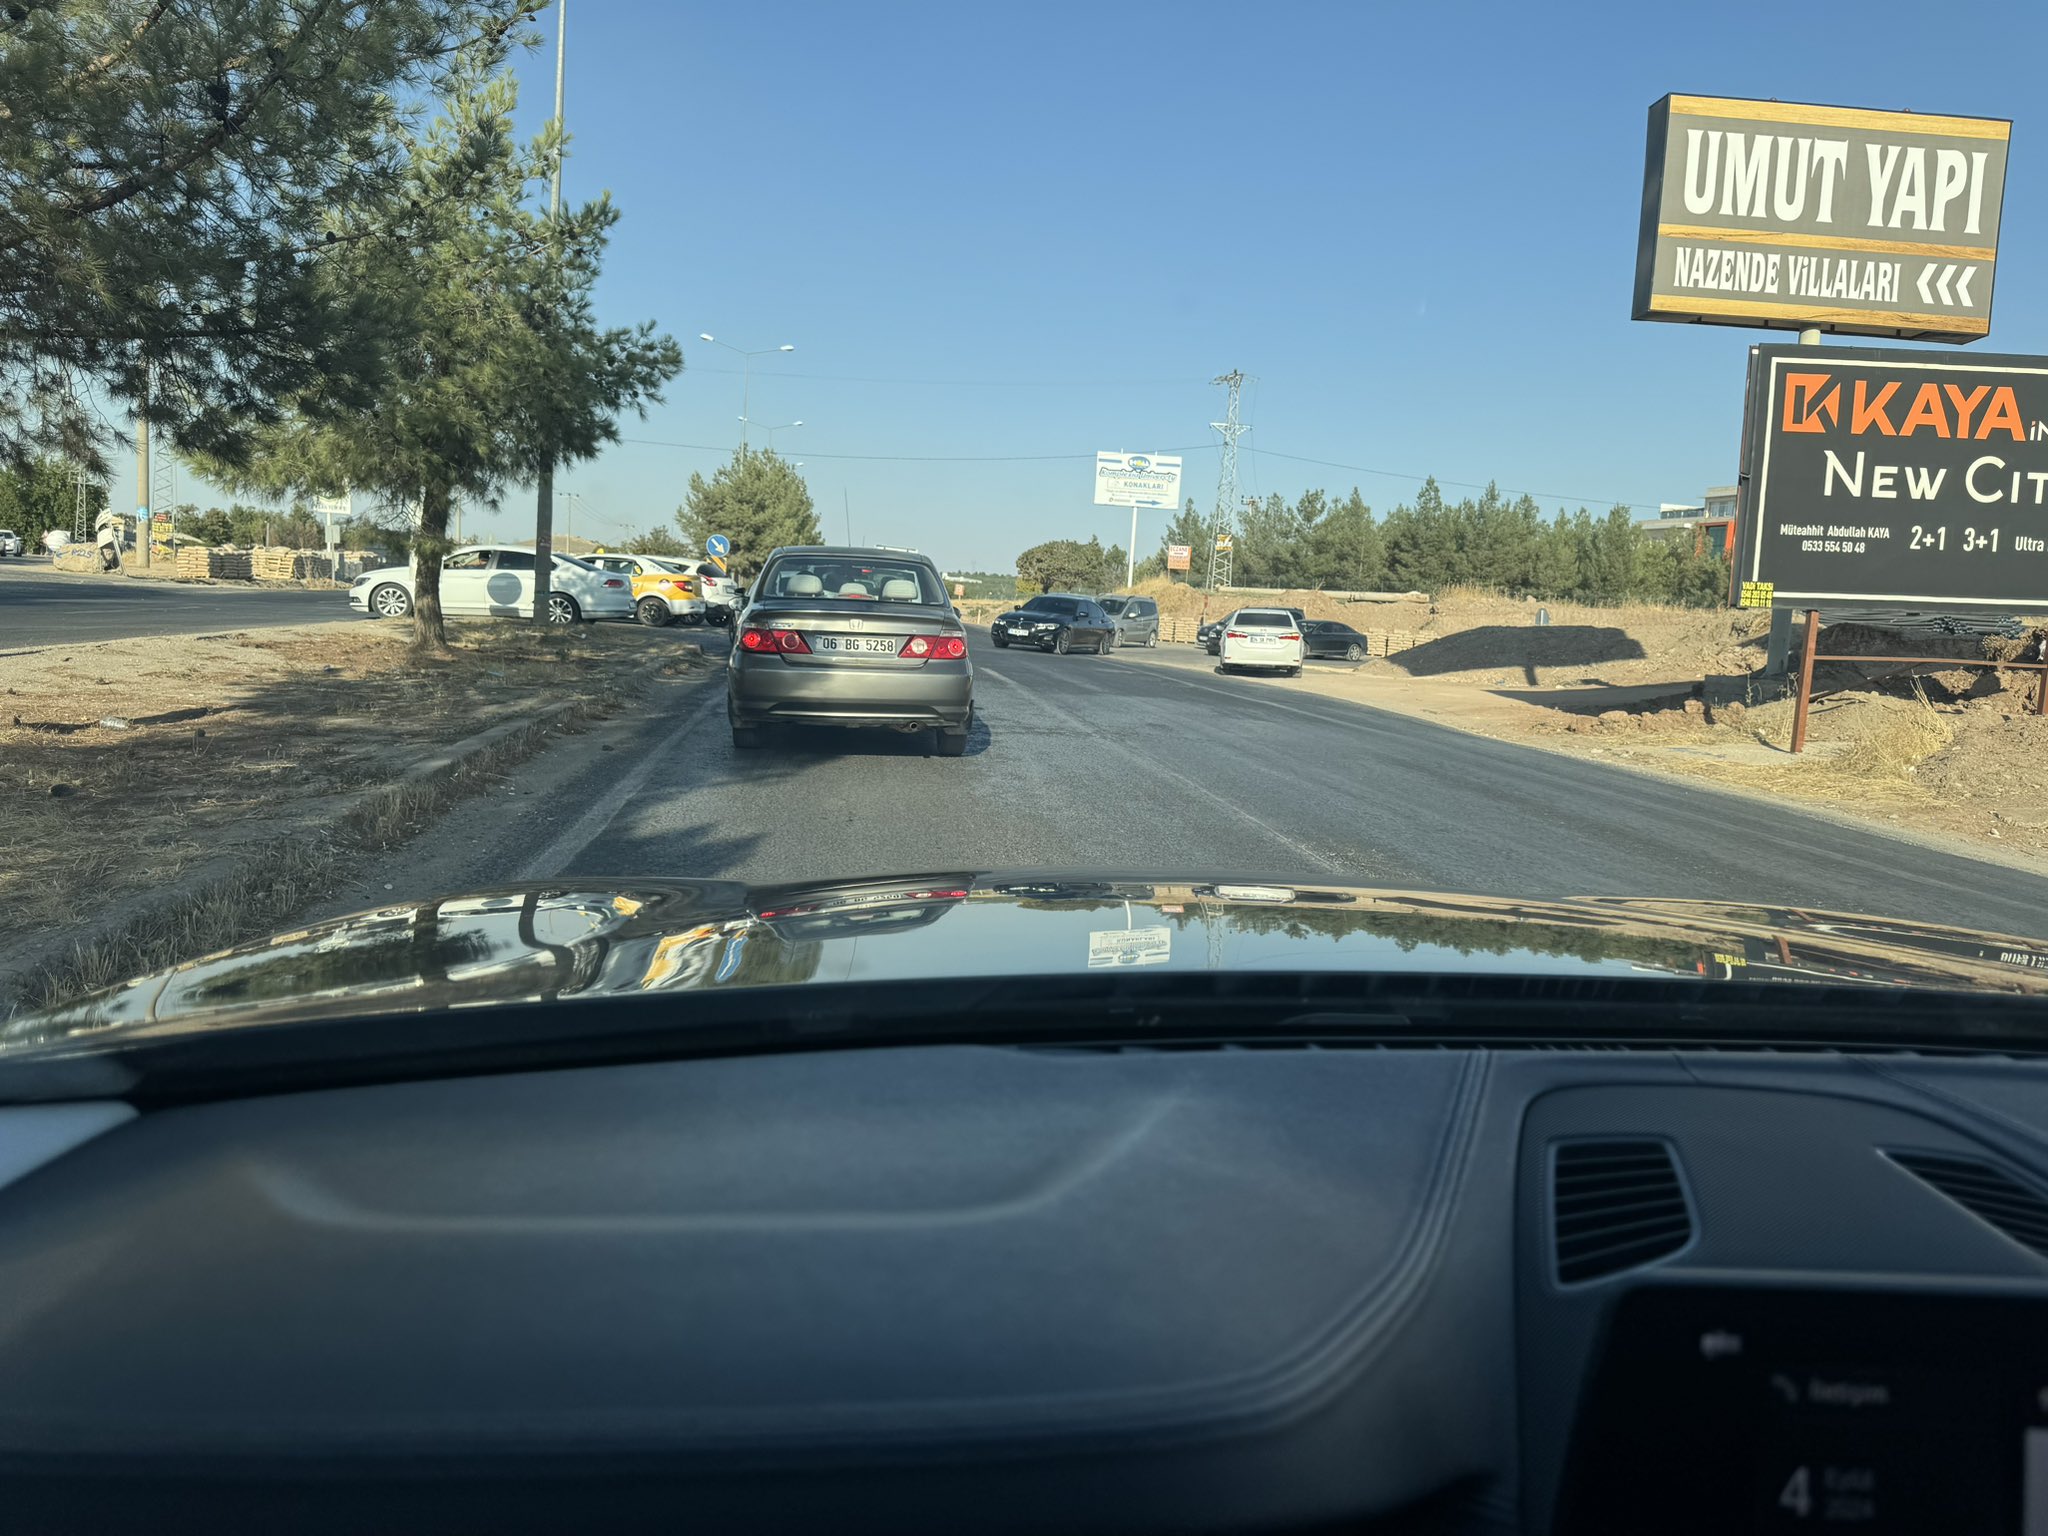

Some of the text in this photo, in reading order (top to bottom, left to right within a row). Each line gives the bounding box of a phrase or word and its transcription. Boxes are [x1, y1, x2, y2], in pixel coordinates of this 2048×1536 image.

[1683, 128, 1989, 234] UMUT YAPI
[1673, 246, 1781, 295] NAZENDE
[1850, 379, 2026, 442] KAYA
[1123, 480, 1164, 490] KONAKLARI
[1823, 449, 1948, 501] NEW
[1780, 523, 1890, 539] Müteahhit Abdullah KAYA
[1909, 525, 2045, 553] 2+1 3+1 Ultra
[1801, 540, 1866, 554] 0533 554 50 48
[822, 637, 894, 652] 06 BG 5258
